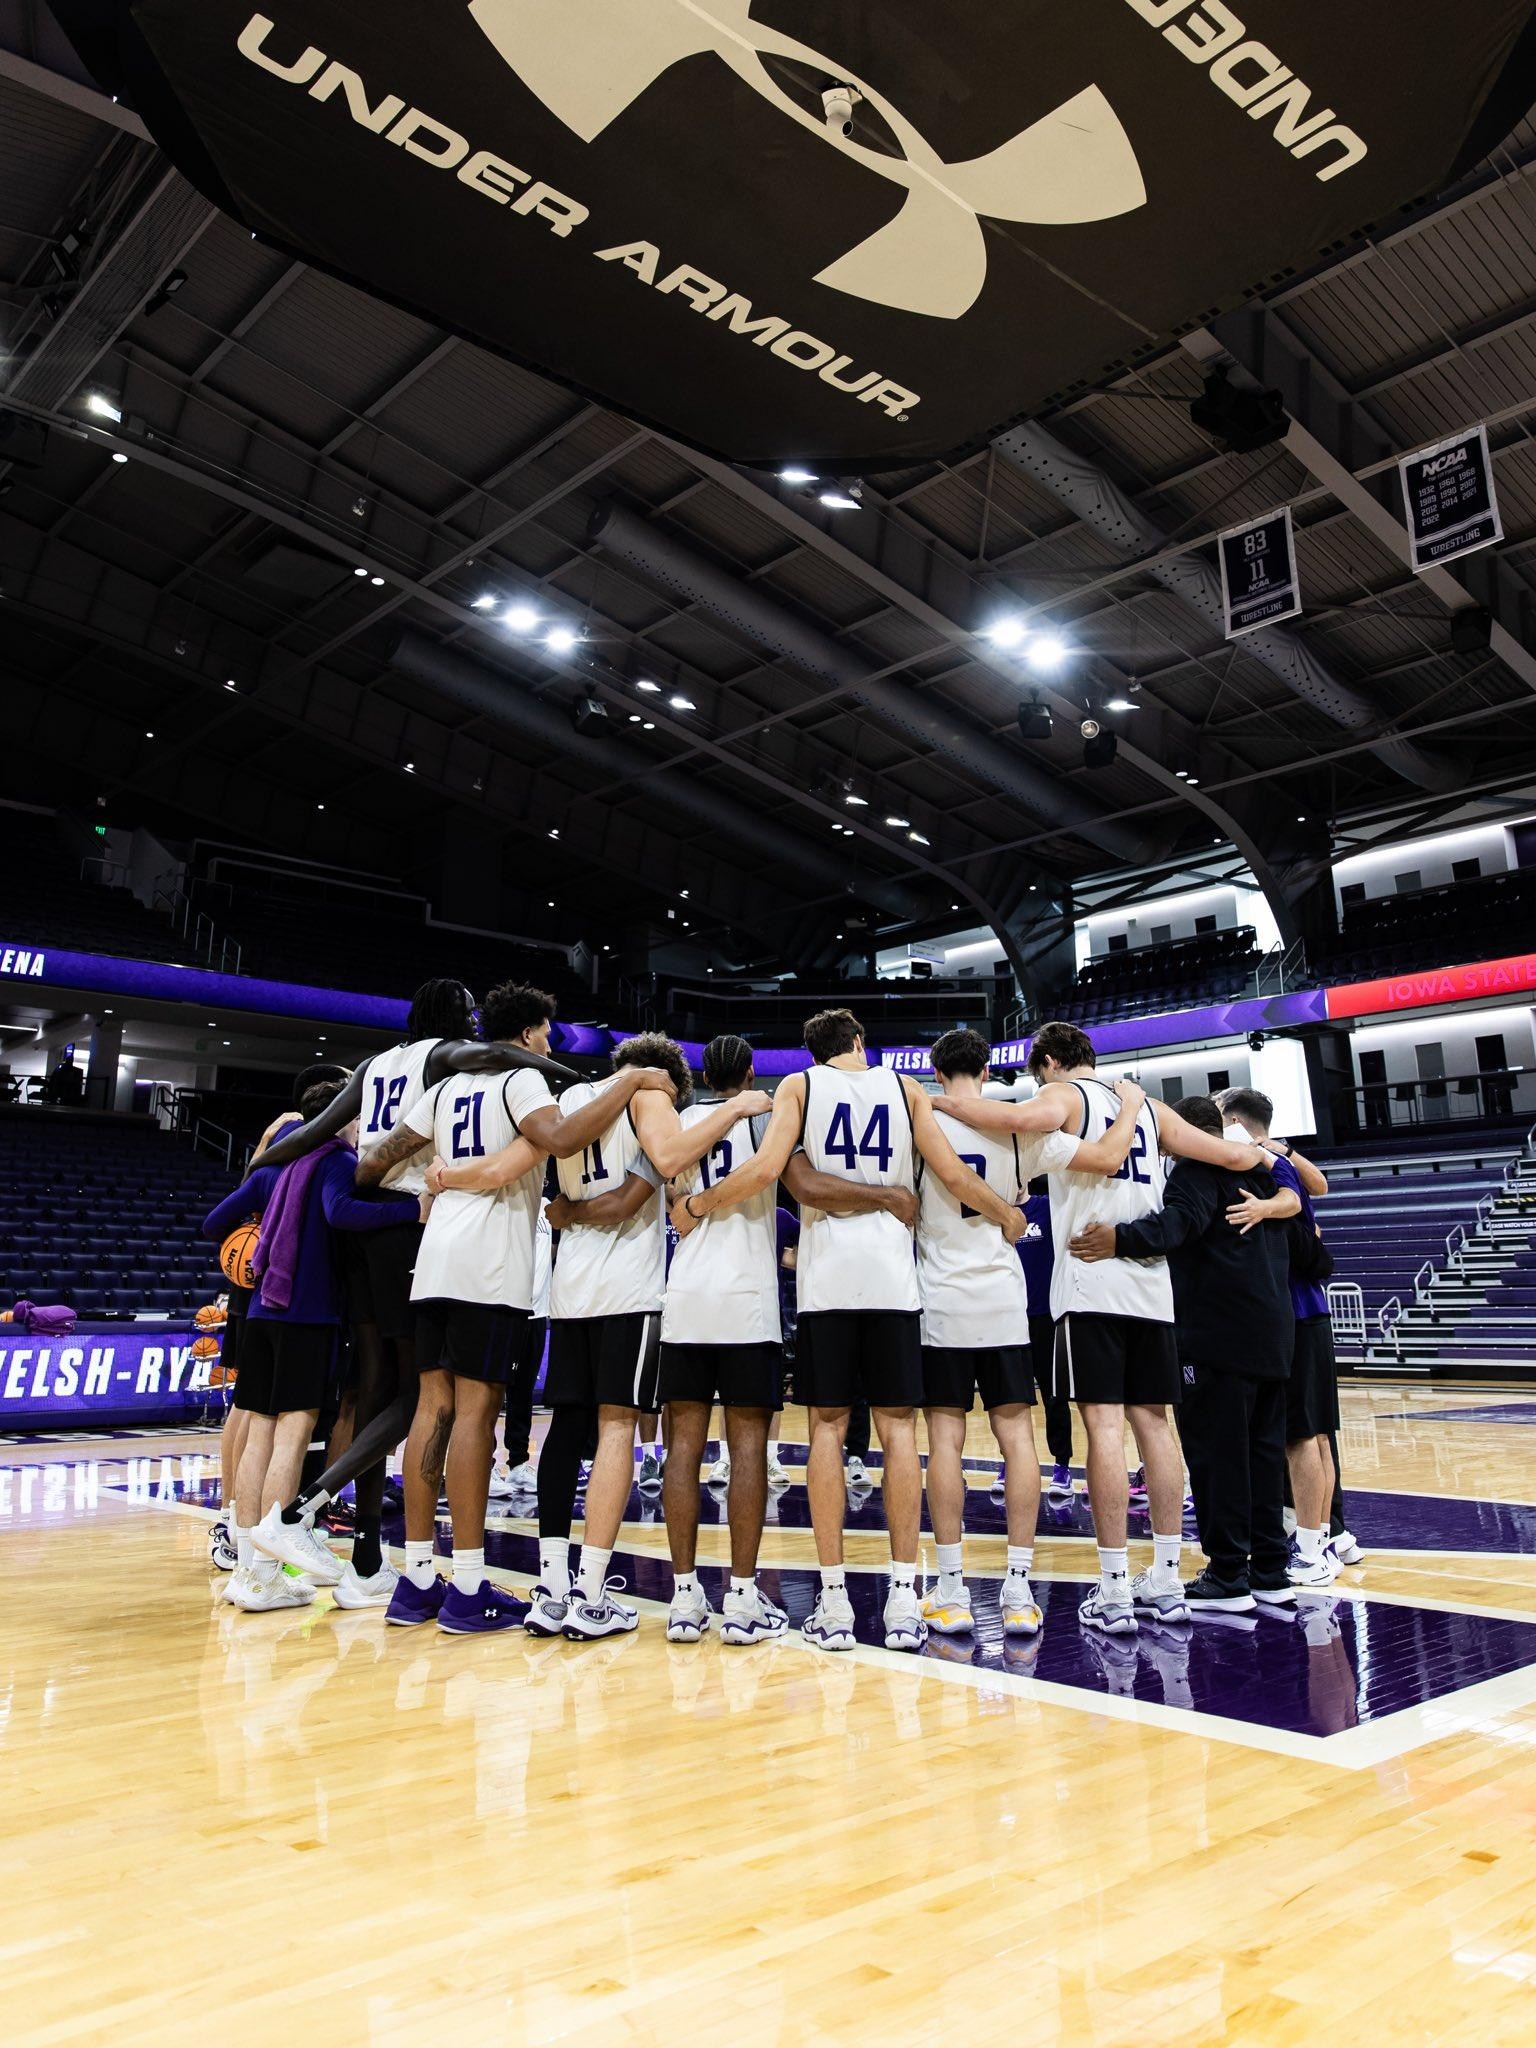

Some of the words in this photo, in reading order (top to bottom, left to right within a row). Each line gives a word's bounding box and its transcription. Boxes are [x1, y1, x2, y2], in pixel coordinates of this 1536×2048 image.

[238, 13, 589, 238] UNDER
[1422, 447, 1468, 478] NCAA
[1418, 485, 1435, 498] 1932
[1439, 477, 1455, 490] 1960
[1459, 467, 1476, 481] 1968
[1460, 477, 1476, 490] 2007
[1441, 497, 1459, 509] 2014
[1244, 530, 1267, 556] 83
[1430, 528, 1480, 556] WRESTLING
[1250, 559, 1266, 582] 11
[1248, 578, 1270, 592] NCAA
[1241, 601, 1283, 623] WRESTLING
[0, 949, 45, 977] ENA
[1387, 976, 1456, 1003] IOWA
[1464, 959, 1536, 991] STATE
[988, 1043, 1025, 1066] RENA
[453, 1091, 486, 1159] 21
[824, 1102, 893, 1172] 44
[0, 1347, 212, 1399] ELSH-RYA
